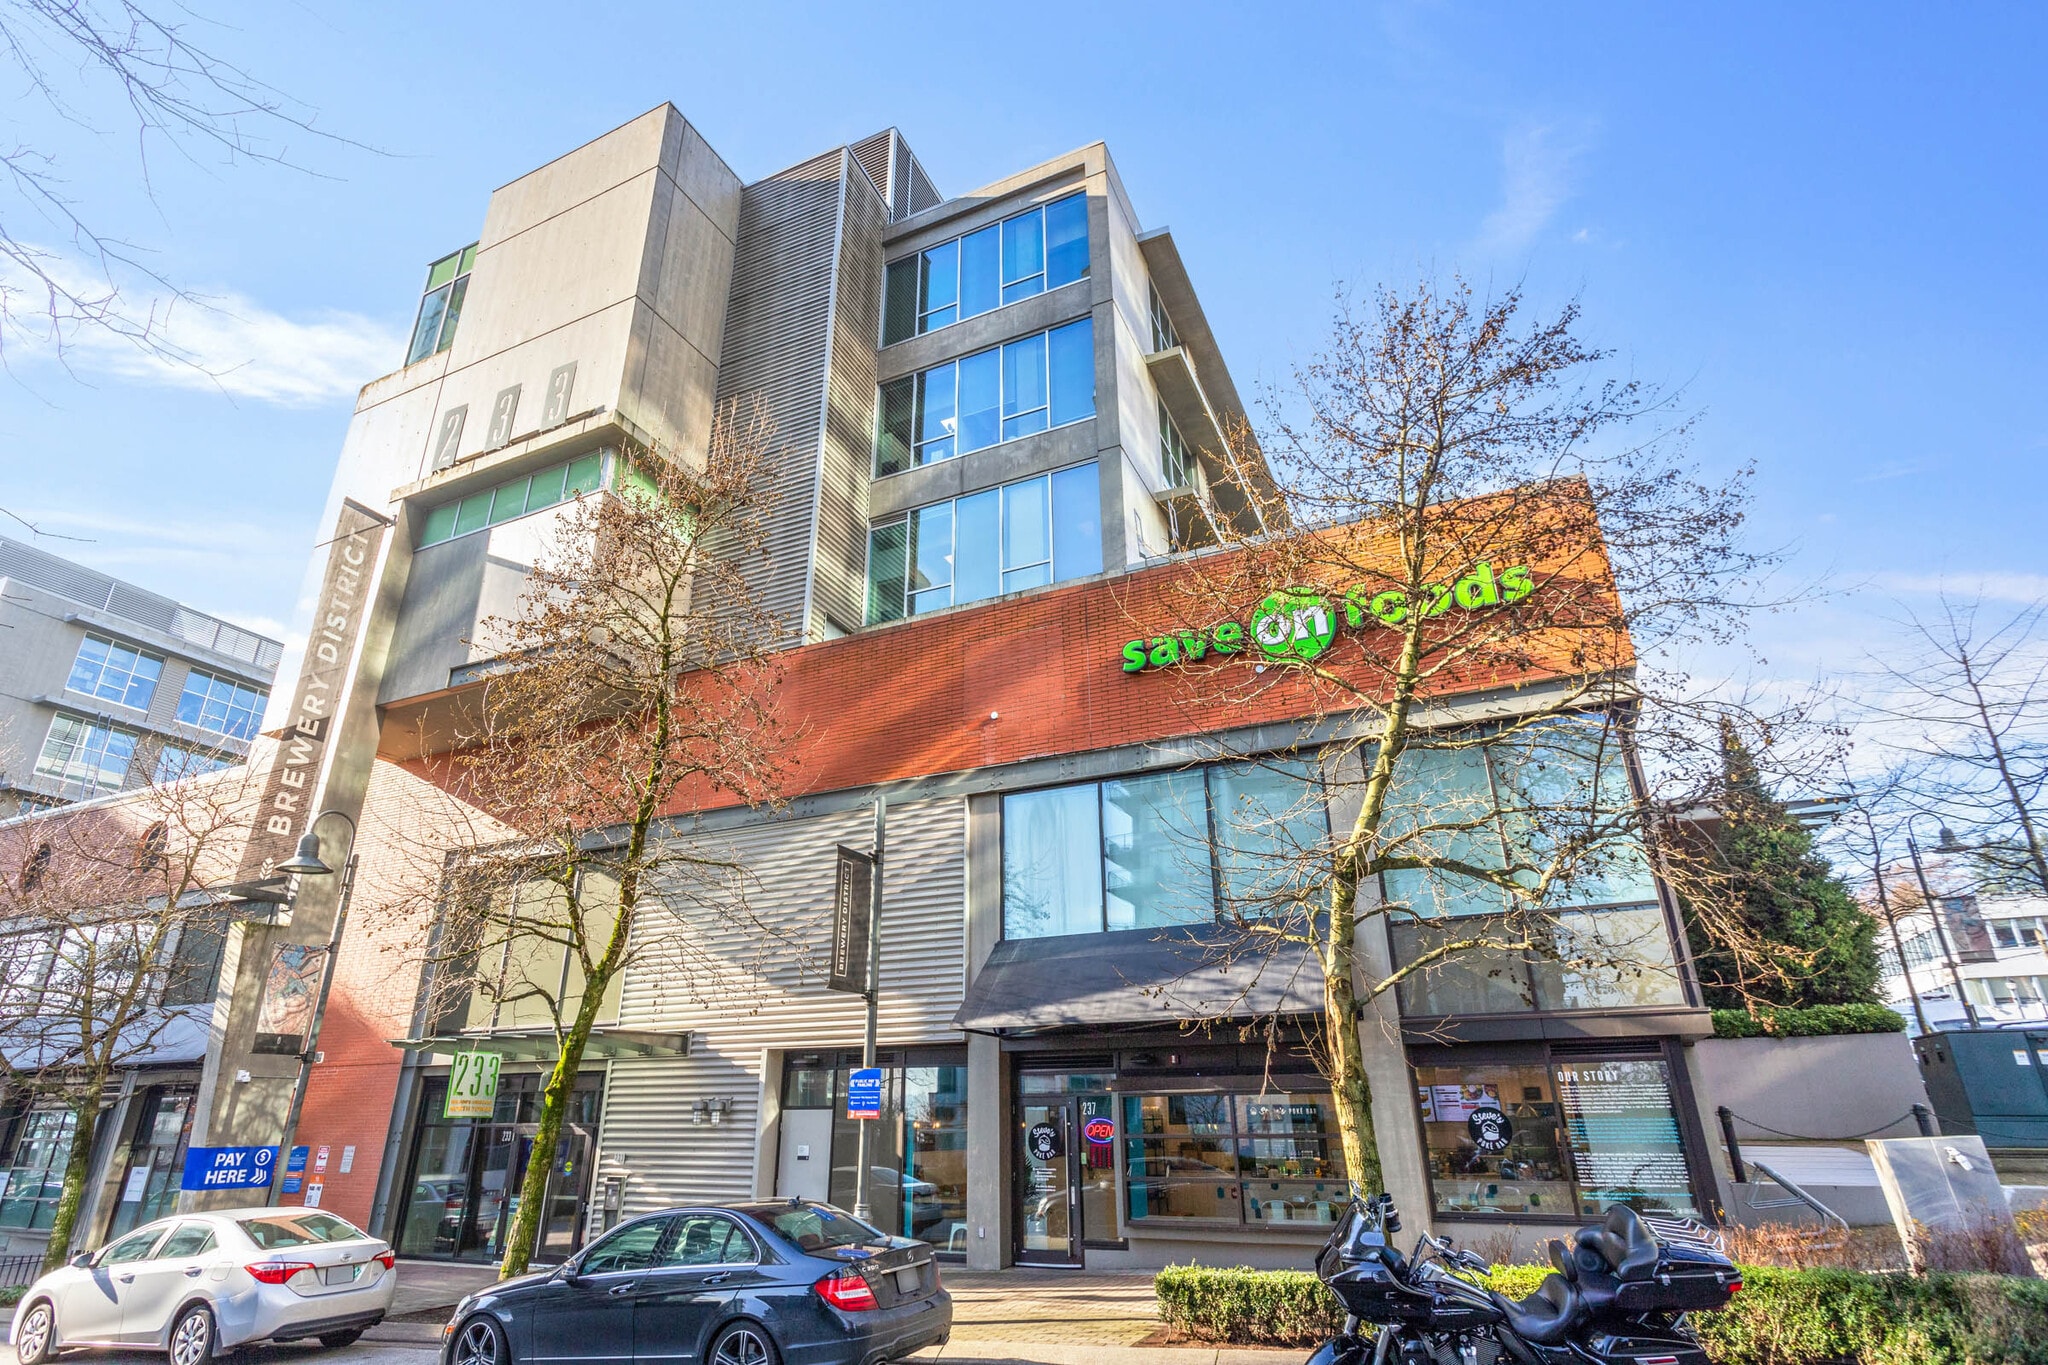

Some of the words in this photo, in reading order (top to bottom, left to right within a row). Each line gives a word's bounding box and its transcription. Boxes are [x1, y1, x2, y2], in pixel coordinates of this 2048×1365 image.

[438, 371, 569, 463] 233
[1122, 622, 1243, 672] save
[1256, 606, 1330, 645] on
[1345, 561, 1535, 628] foods
[267, 671, 331, 836] BREWERY
[317, 527, 369, 665] DISTRICT
[842, 867, 850, 914] DISTRICT
[838, 919, 848, 971] BREWERY
[453, 1054, 499, 1096] 233
[1557, 1071, 1579, 1082] OUR
[1583, 1070, 1618, 1082] STORY
[1082, 1102, 1096, 1115] 237
[1472, 1112, 1505, 1125] Steve's
[502, 1130, 512, 1142] 233
[1032, 1126, 1056, 1138] Steve's
[1086, 1124, 1114, 1138] OPEN
[214, 1152, 247, 1168] PAY
[204, 1169, 248, 1185] HERE
